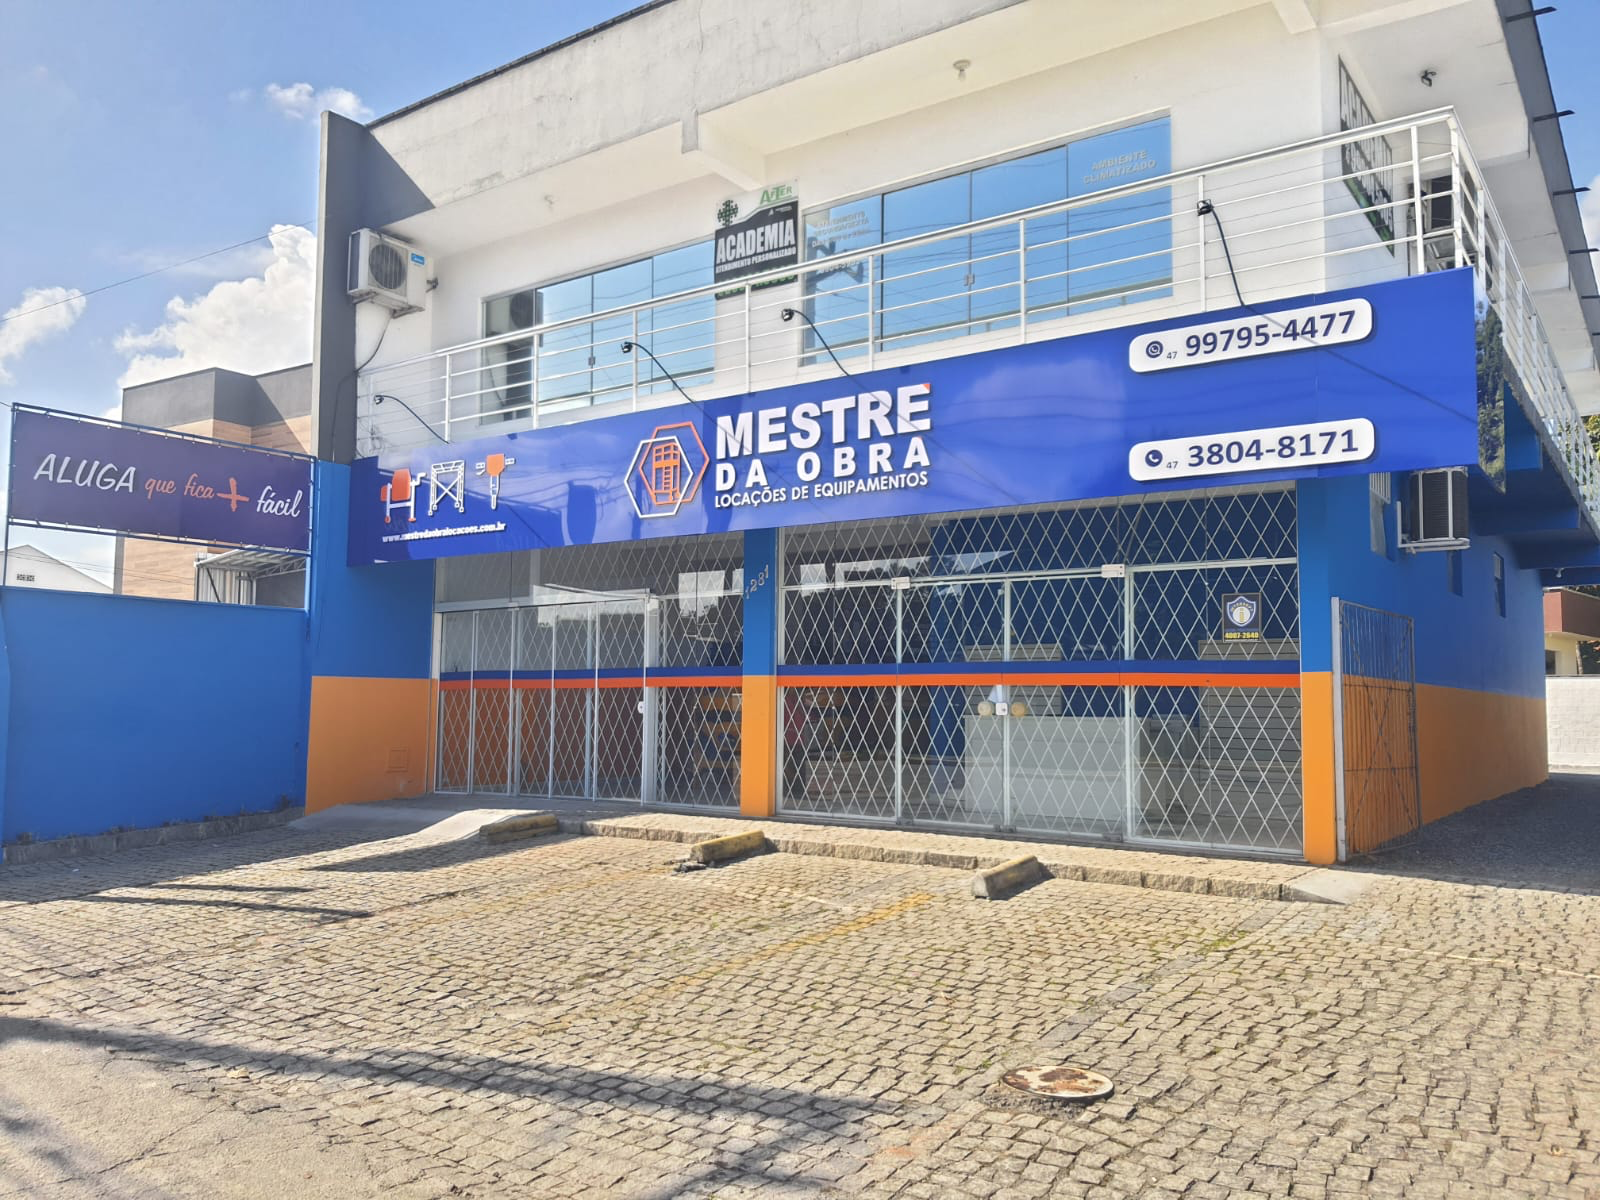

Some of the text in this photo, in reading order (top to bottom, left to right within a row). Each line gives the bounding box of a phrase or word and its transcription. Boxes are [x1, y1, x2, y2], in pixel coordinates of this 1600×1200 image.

[716, 219, 796, 264] ACADEMIA
[1166, 310, 1356, 360] 47 99795-4477
[716, 383, 931, 460] MESTRE
[715, 437, 931, 492] DA OBRA
[1166, 429, 1359, 470] 47 3804-8171
[33, 453, 137, 493] ALUGA
[144, 476, 177, 500] que
[183, 472, 215, 499] fica
[256, 485, 303, 518] fácil
[714, 472, 928, 508] LOCAÇÕES DE EQUIPAMENTOS
